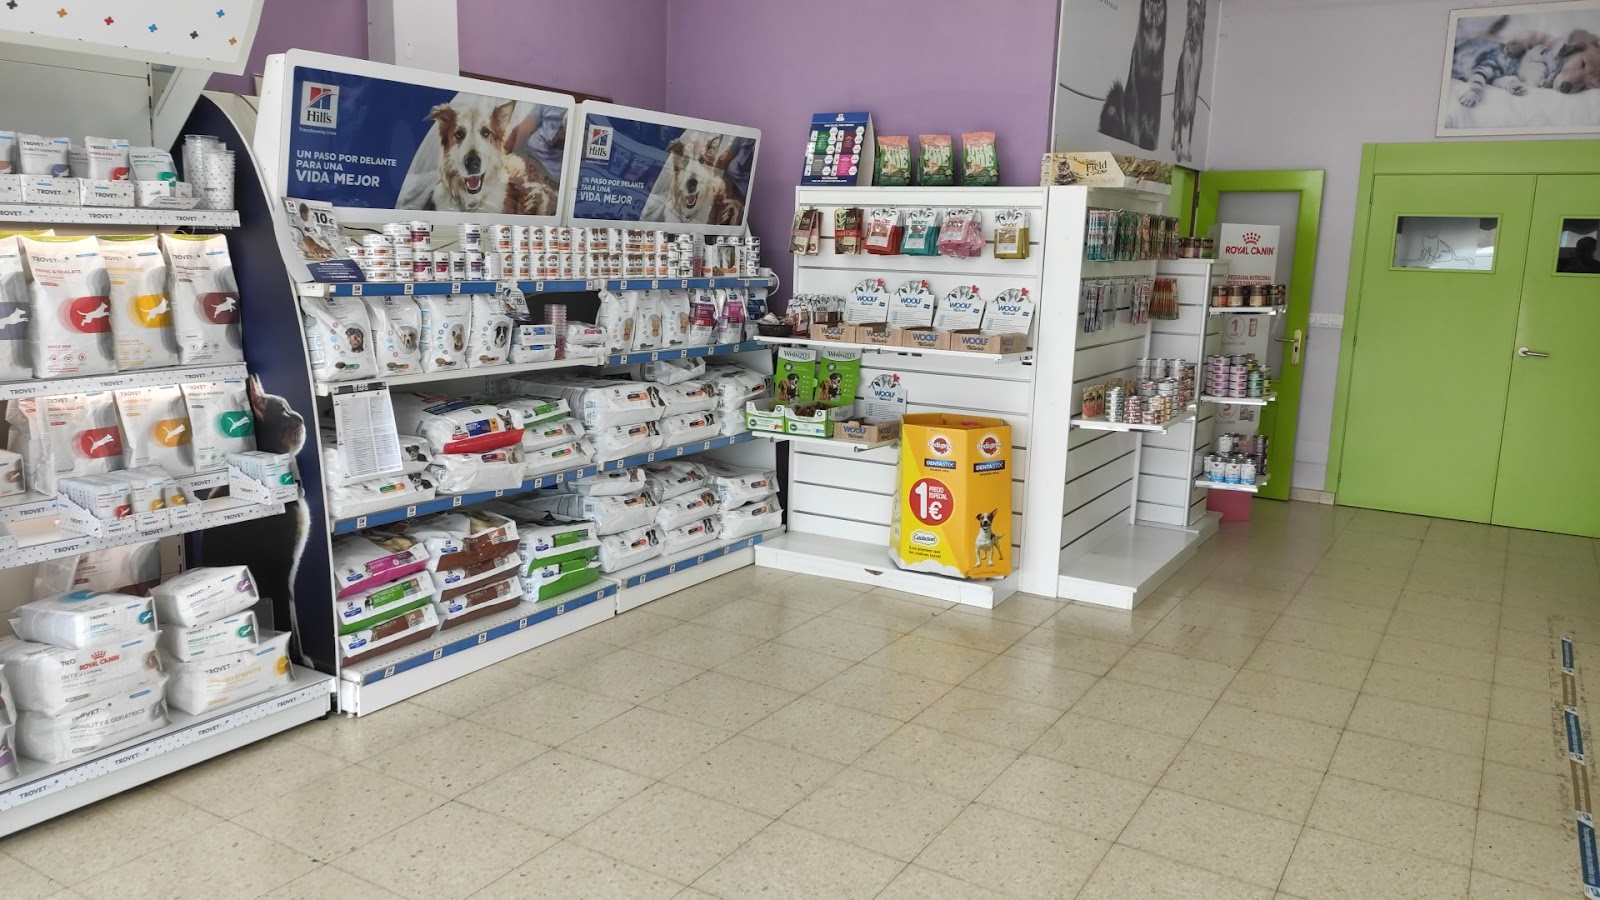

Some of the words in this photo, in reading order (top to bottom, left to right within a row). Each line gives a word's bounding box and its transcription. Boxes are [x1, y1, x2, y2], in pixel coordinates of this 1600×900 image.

[296, 150, 312, 158] UN
[314, 152, 336, 160] PASO
[339, 154, 358, 163] POR
[360, 156, 397, 166] DELANTE
[296, 160, 322, 170] PARA
[324, 162, 343, 171] UNA
[296, 169, 330, 184] VIDA
[334, 172, 380, 187] MEJOR
[621, 180, 644, 189] DELANTE
[580, 191, 600, 201] VIDA
[603, 194, 632, 204] MEJOR
[314, 212, 328, 224] 10
[1226, 246, 1250, 254] ROYAL
[1250, 247, 1274, 256] CANIN
[32, 256, 58, 264] TROVET
[856, 295, 878, 303] WOOLF
[900, 296, 922, 305] WOOLF
[950, 302, 973, 310] WOOLF
[820, 326, 845, 336] WOOLF
[912, 332, 939, 342] WOOLF
[962, 336, 989, 345] WOOLF
[10, 387, 37, 395] TROVET
[874, 390, 896, 398] WOOLF
[844, 425, 867, 435] WOOLF
[927, 440, 954, 451] Pedigree
[976, 441, 1003, 450] Pedigree
[926, 460, 954, 468] DENTASTIX
[976, 462, 1003, 471] DENTASTIX
[190, 480, 211, 488] TROVET
[915, 482, 928, 520] 1
[929, 492, 948, 500] ESPECIAL
[20, 507, 46, 516] TROVET
[929, 501, 942, 520] €
[224, 512, 244, 520] TROVET
[141, 528, 164, 537] TROVET
[53, 544, 80, 554] TROVET
[60, 659, 76, 667] TRO
[79, 661, 99, 671] ROYAL
[100, 654, 120, 666] CANIN
[204, 664, 231, 674] TROVET
[277, 697, 296, 708] TROVET
[110, 708, 145, 723] GERIATRICS
[198, 724, 220, 736] TROVET
[114, 752, 140, 765] TROVET
[19, 785, 47, 800] TROVET
